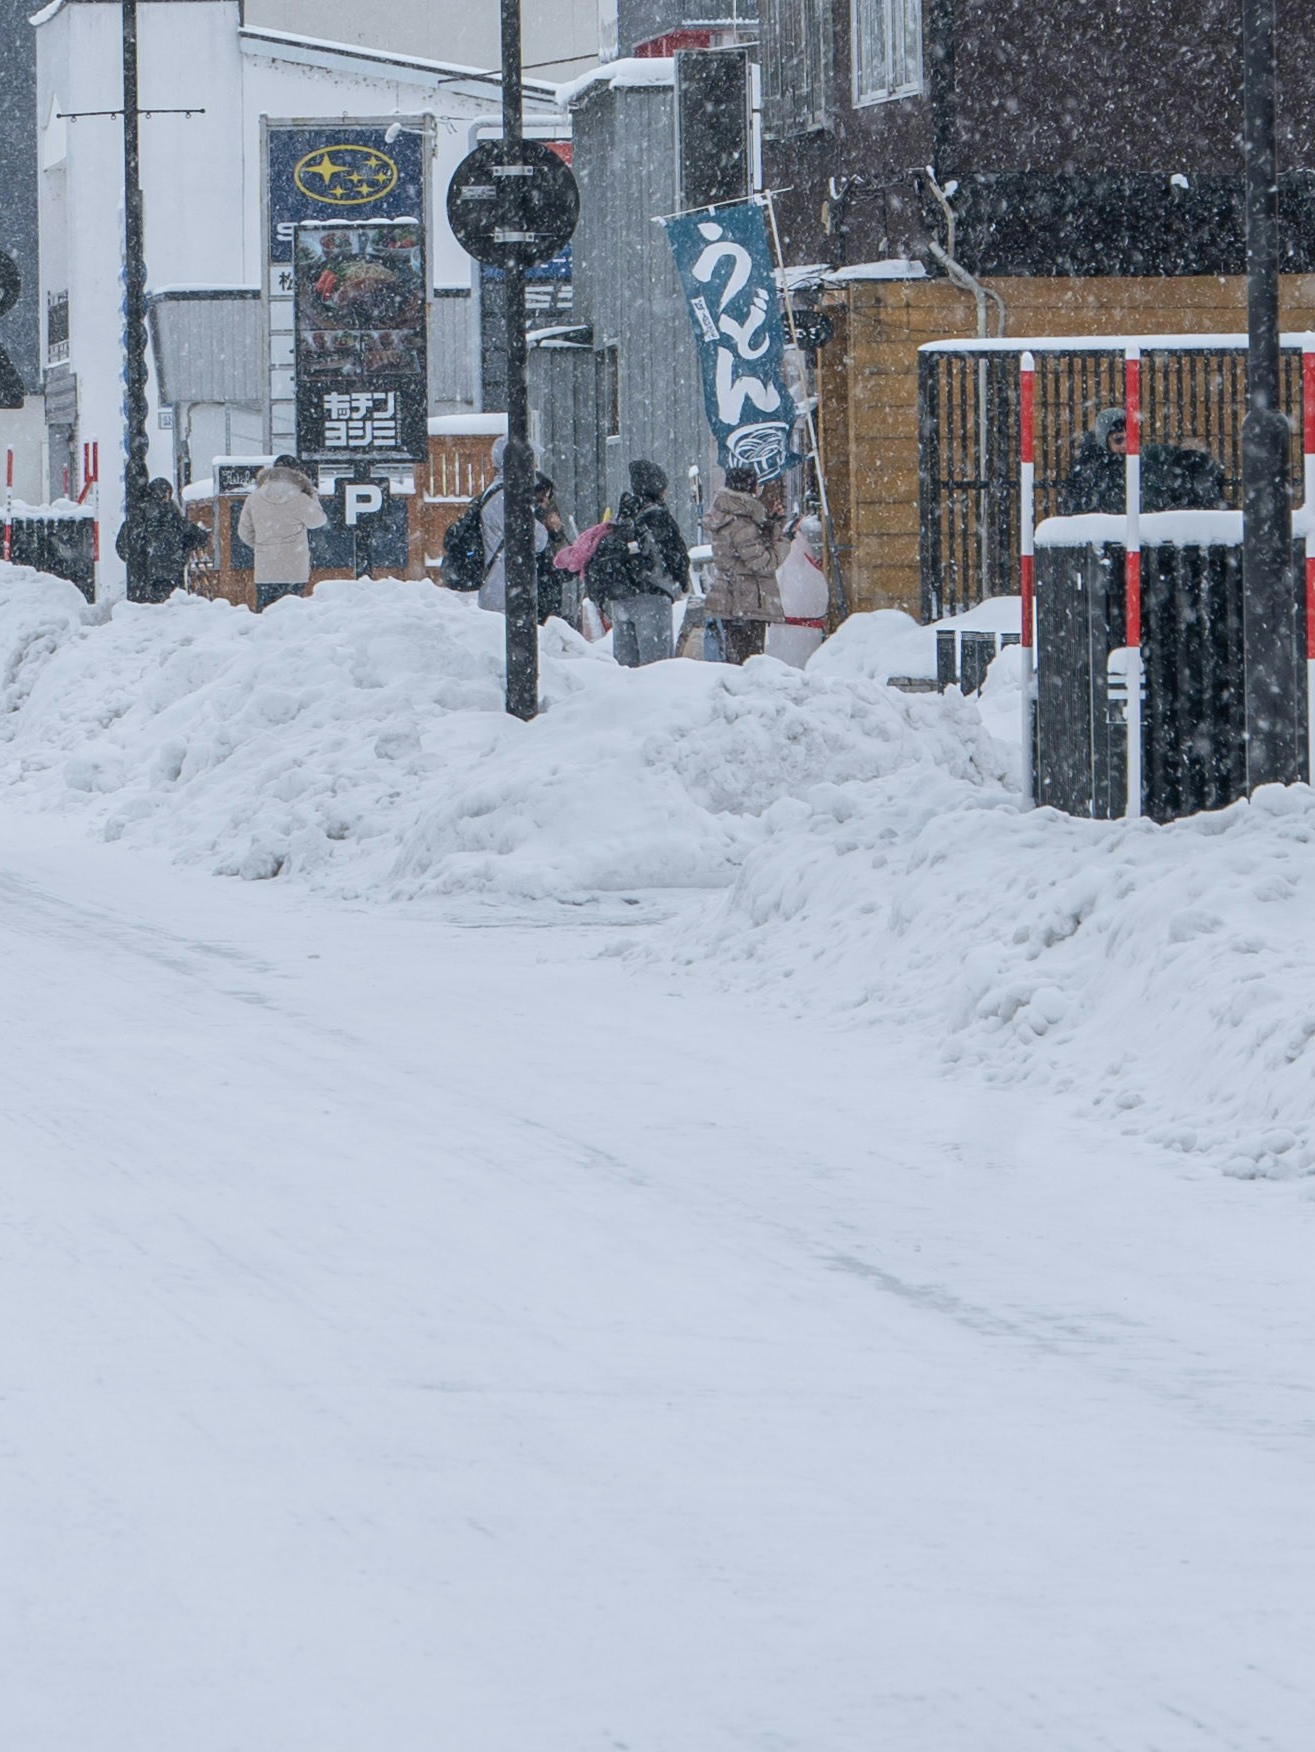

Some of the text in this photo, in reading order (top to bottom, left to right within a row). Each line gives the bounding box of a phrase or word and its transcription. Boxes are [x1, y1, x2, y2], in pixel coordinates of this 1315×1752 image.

[692, 222, 781, 425] うどん
[324, 391, 395, 420] キッチン
[325, 421, 396, 446] ヨシミ
[345, 484, 382, 525] P
